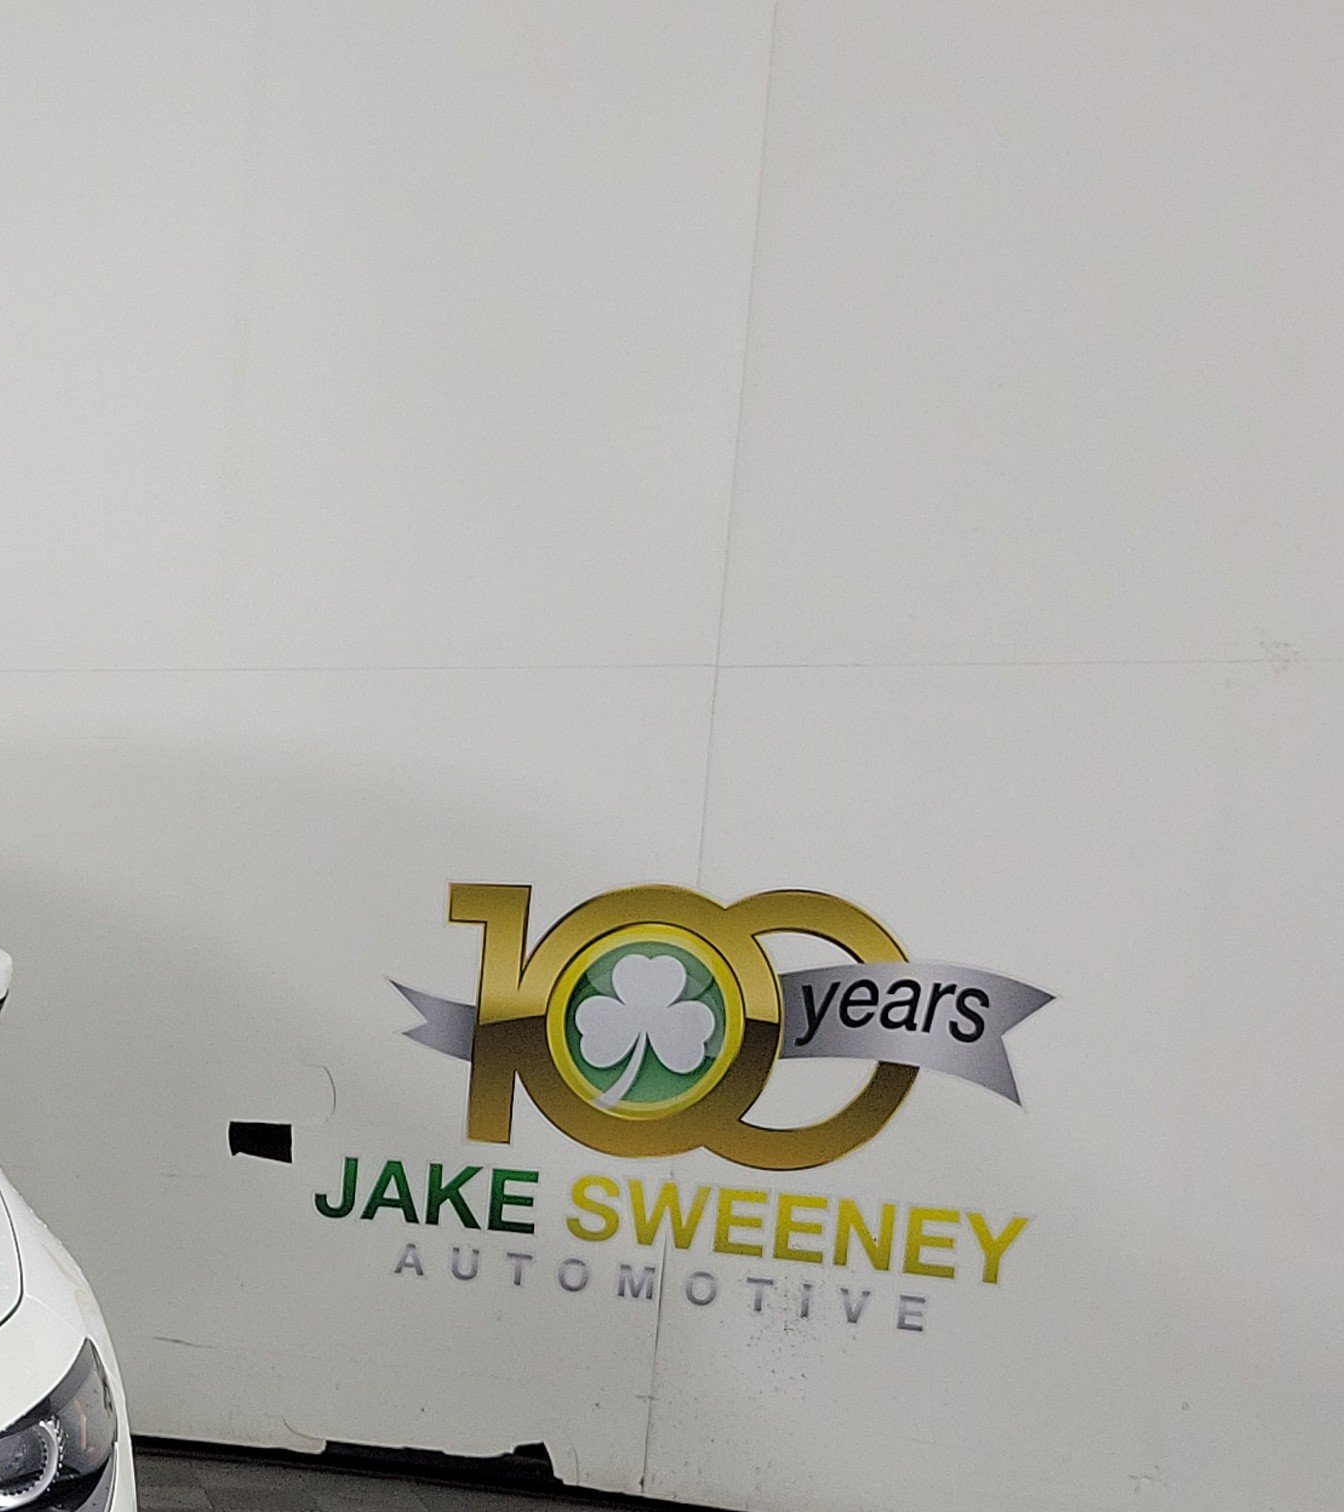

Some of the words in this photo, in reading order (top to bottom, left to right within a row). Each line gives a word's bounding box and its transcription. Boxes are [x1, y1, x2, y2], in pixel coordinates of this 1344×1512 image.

[448, 881, 919, 1170] 100
[796, 974, 990, 1045] years
[315, 1157, 536, 1234] JAKE
[566, 1175, 1028, 1284] SWEENEY
[394, 1243, 927, 1332] AUTOMOTIVE
